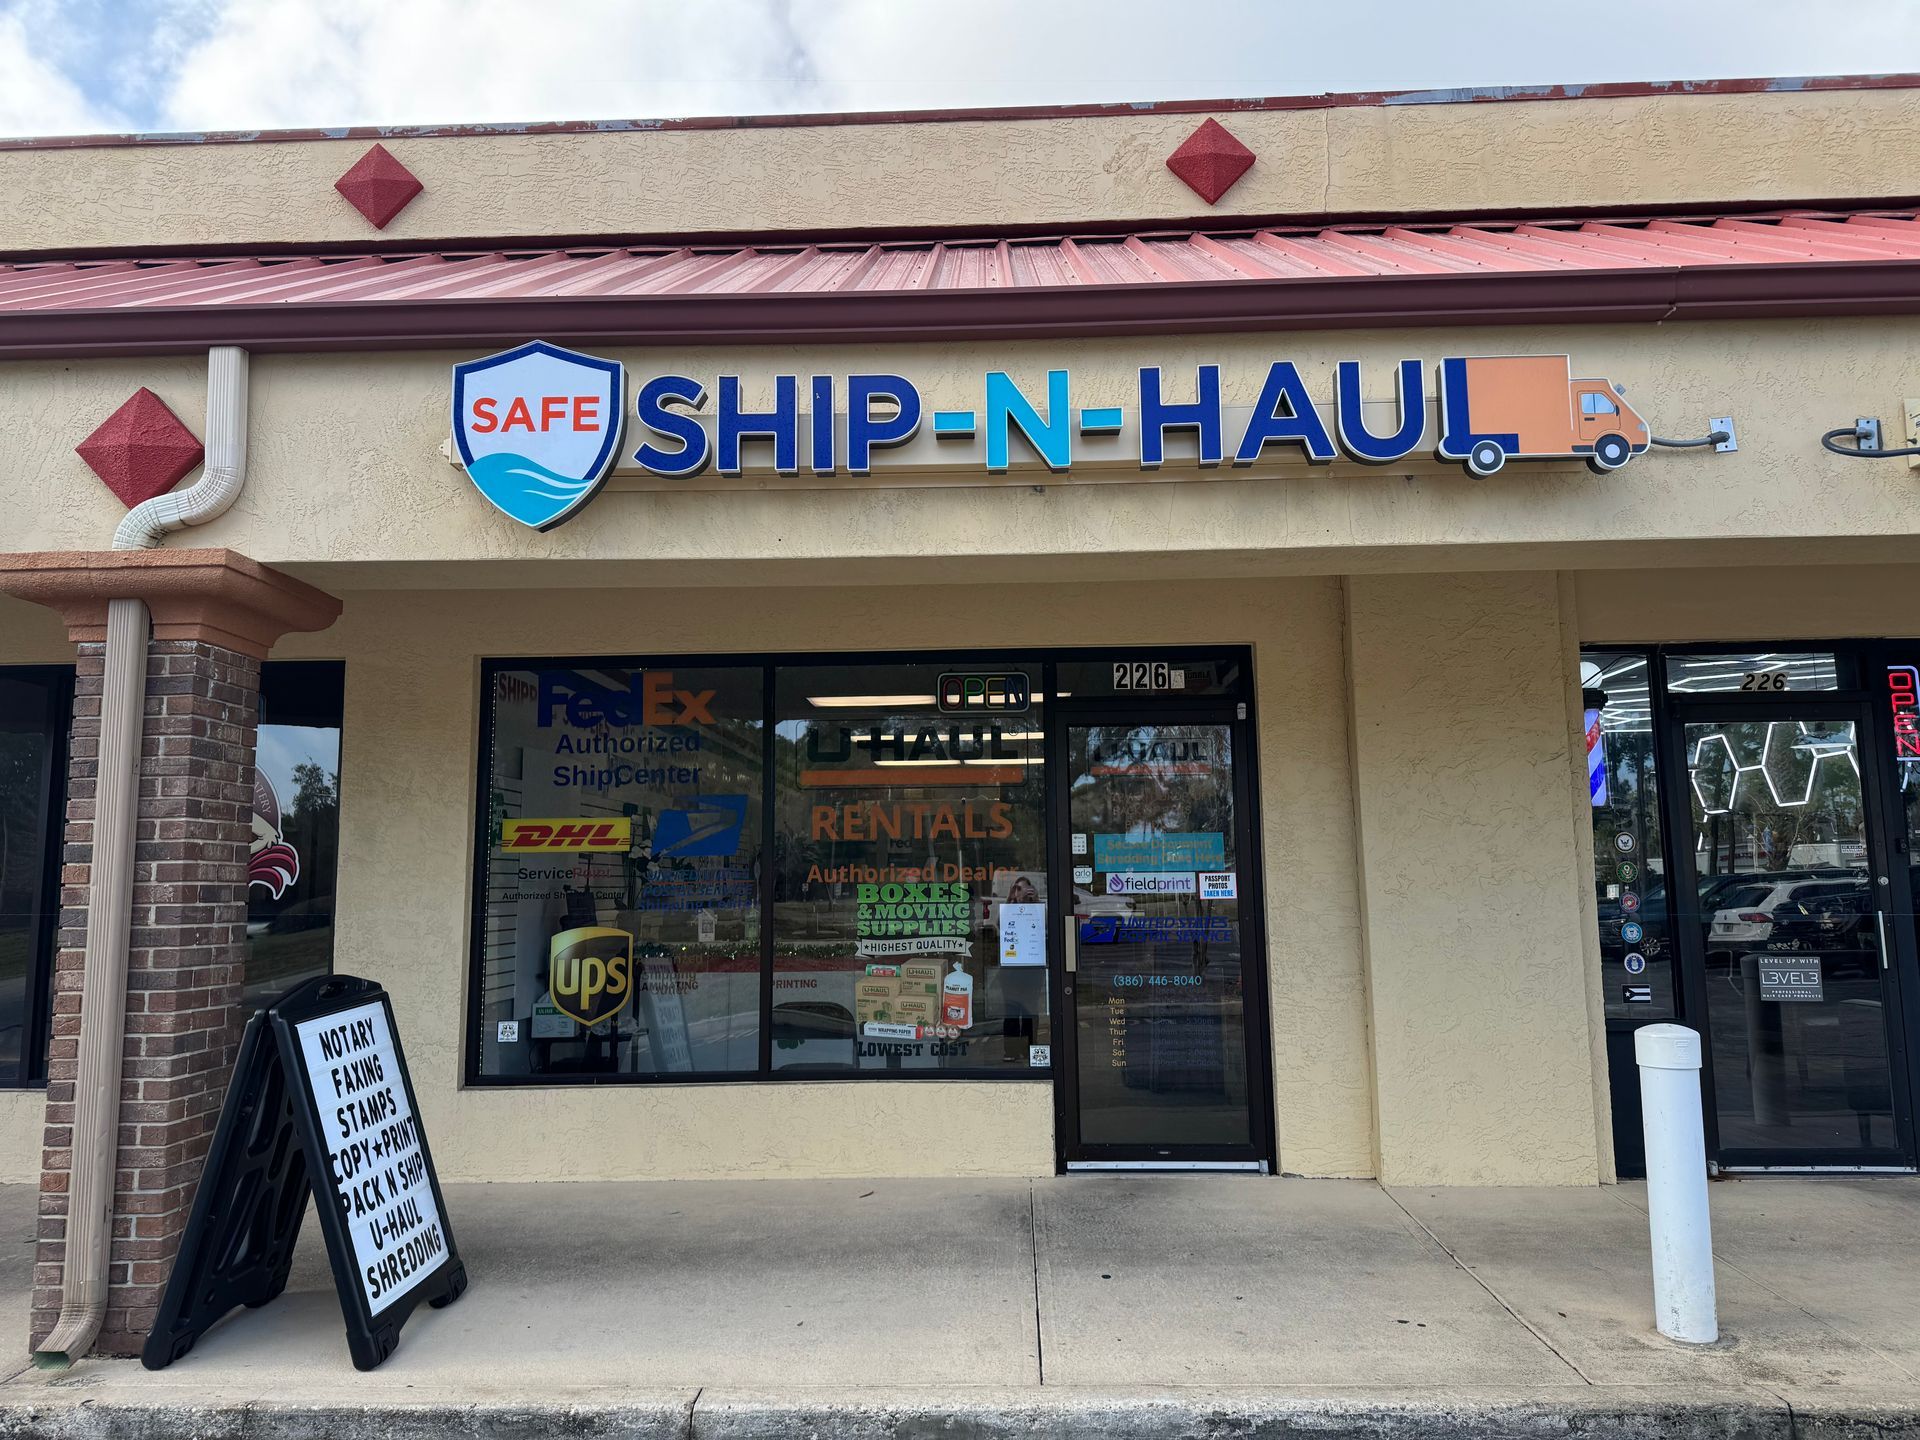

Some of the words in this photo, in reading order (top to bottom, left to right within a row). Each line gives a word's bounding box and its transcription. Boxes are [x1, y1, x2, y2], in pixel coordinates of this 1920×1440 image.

[471, 396, 600, 433] SAFE
[1115, 663, 1168, 689] 226
[1742, 673, 1786, 691] 226
[538, 671, 718, 728] FedEx
[942, 677, 1026, 710] OPEN
[1888, 672, 1920, 756] OPEN
[555, 732, 702, 755] Authorized
[807, 725, 1019, 762] U-HAUL
[553, 764, 703, 791] ShipCenter
[254, 777, 271, 813] ATERY
[812, 803, 1014, 841] RENTALS
[512, 824, 620, 848] DHL
[807, 863, 935, 884] Authorized
[943, 863, 1019, 882] Dealer
[1125, 877, 1191, 892] fieldprint
[502, 891, 550, 900] Authorized
[596, 890, 625, 900] Center
[857, 883, 970, 903] BOXES
[857, 904, 872, 919] &
[874, 904, 970, 919] MOVING
[857, 920, 970, 936] SUPPLIES
[870, 942, 913, 952] HIGHEST
[916, 940, 958, 950] QUALITY
[556, 956, 627, 1011] ups
[908, 968, 934, 976] U-HAUL
[1113, 975, 1143, 987] (386)
[1148, 975, 1202, 985] 446-8040
[1109, 1017, 1126, 1025] Wed
[1110, 1007, 1125, 1015] Tue
[319, 1017, 376, 1062] NOTARY
[857, 1041, 923, 1057] LOWEST
[930, 1041, 969, 1057] COST
[1112, 1038, 1124, 1046] Fri
[1111, 1059, 1127, 1067] Sun
[331, 1053, 384, 1099] FAXING
[337, 1087, 397, 1139] STAMPS
[341, 1181, 383, 1220] PACK
[385, 1167, 399, 1197] N
[398, 1151, 424, 1190] SHIP
[369, 1196, 423, 1251] U-HAUL
[367, 1223, 442, 1300] SHREDDING
